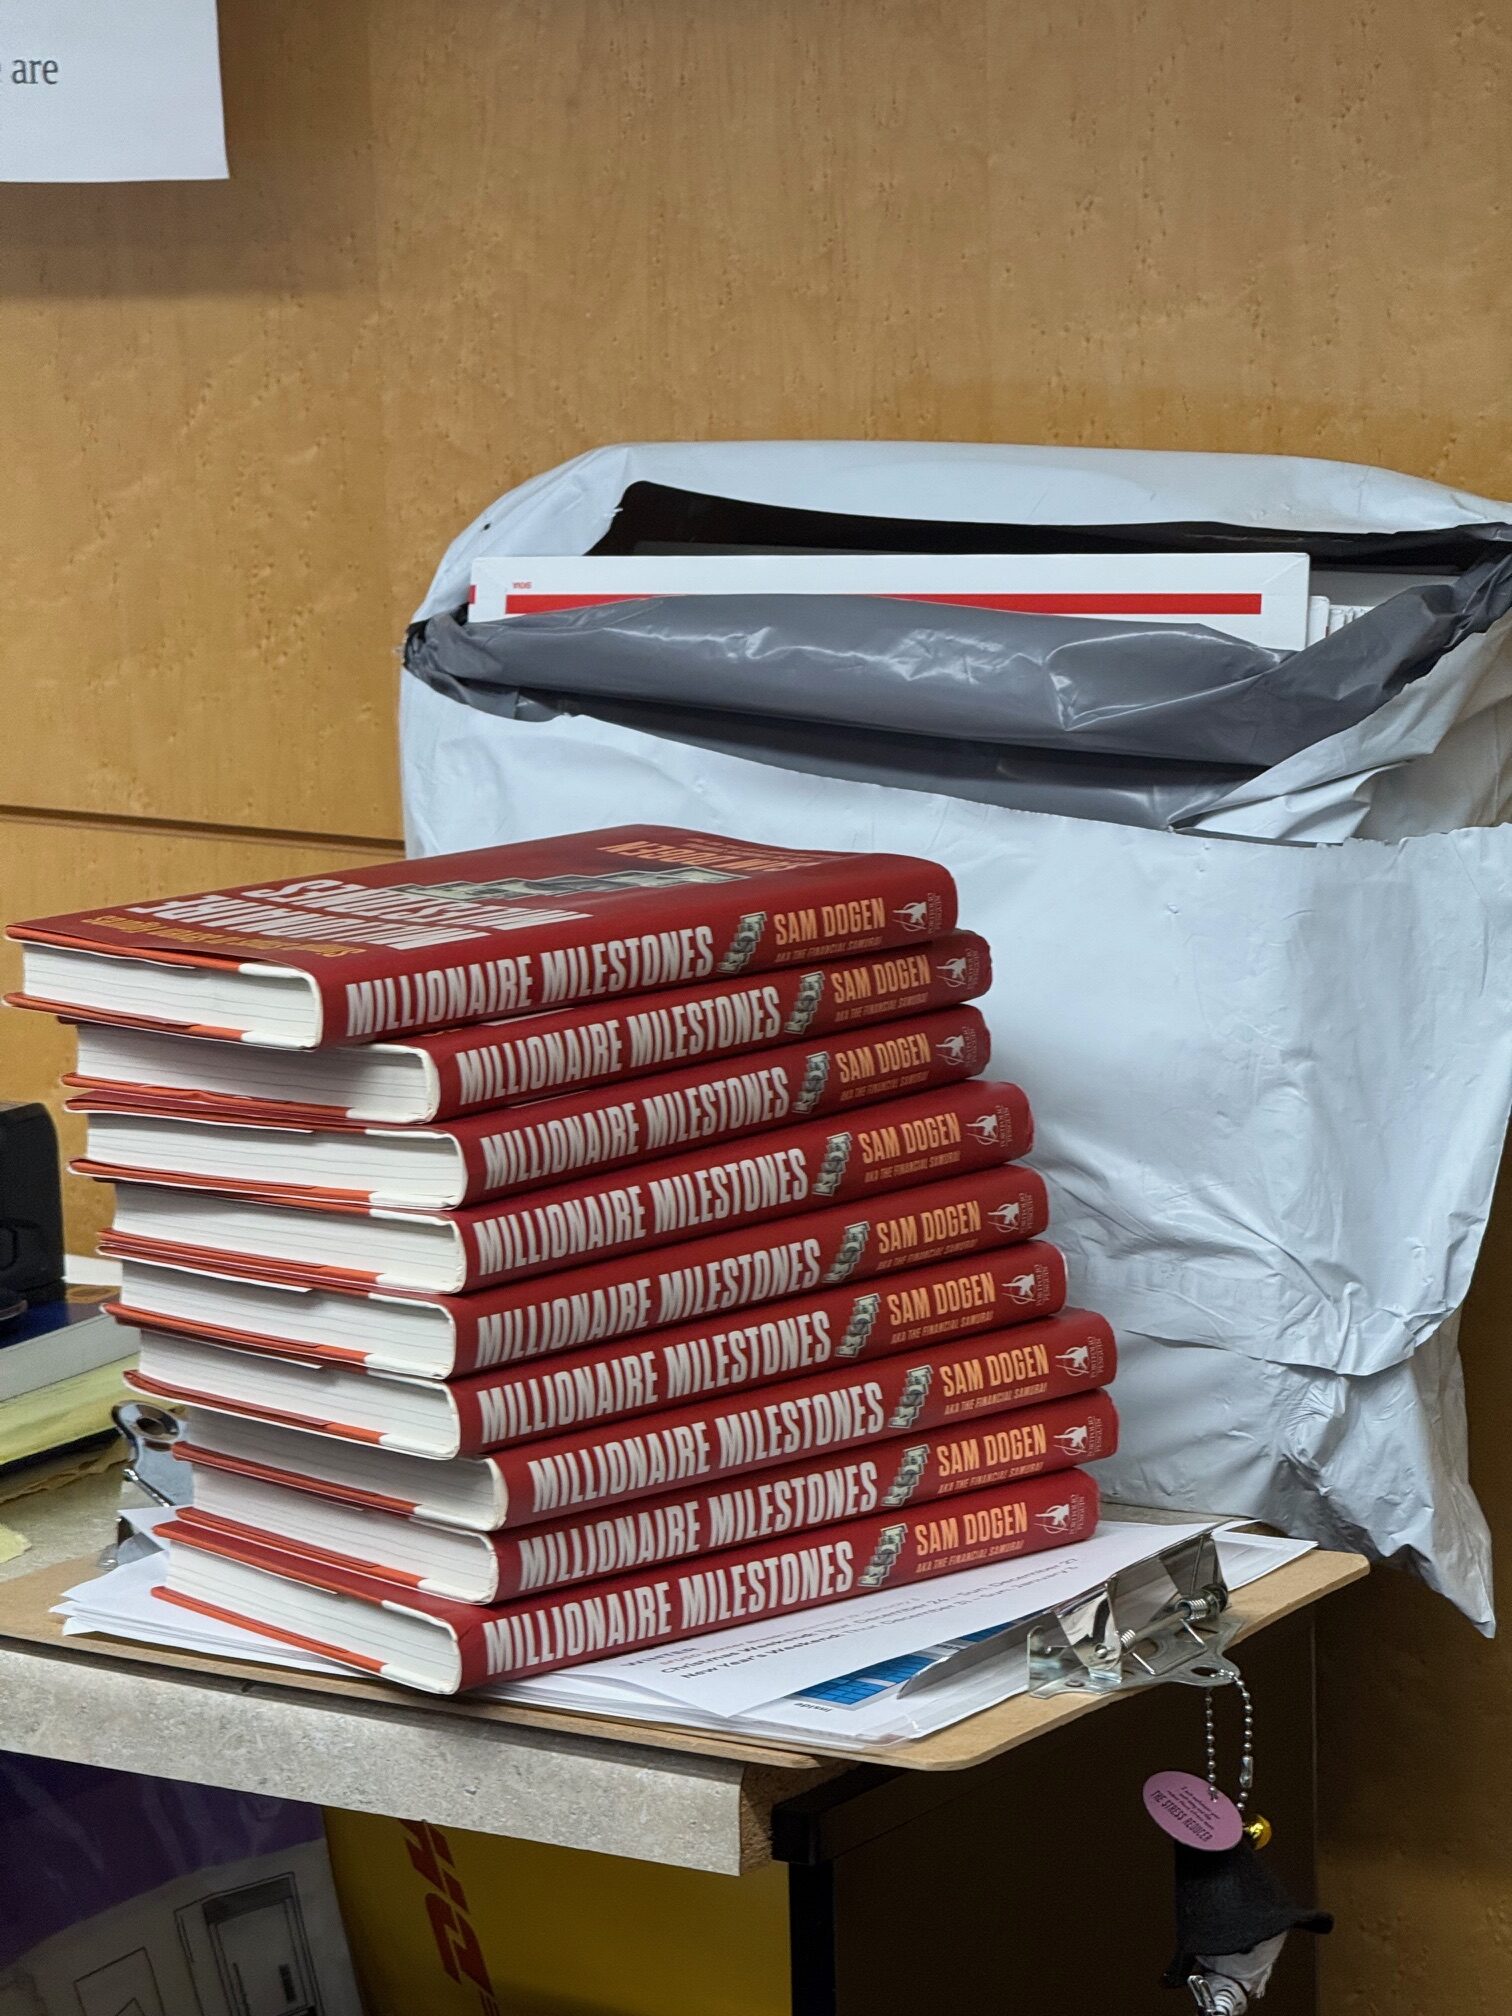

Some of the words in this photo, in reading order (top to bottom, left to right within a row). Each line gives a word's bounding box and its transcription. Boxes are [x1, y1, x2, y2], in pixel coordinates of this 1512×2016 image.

[12, 60, 58, 84] are
[125, 895, 492, 950] MILLIONAIRE
[240, 879, 594, 931] MILESTONES
[773, 908, 817, 945] SAM
[821, 897, 885, 937] DOGEN
[345, 955, 532, 1033] MILLIONAIRE
[540, 925, 713, 991] MILESTONES
[830, 967, 871, 1003] SAM
[872, 957, 930, 995] DOGEN
[455, 1019, 622, 1096] MILLIONAIRE
[626, 986, 780, 1057] MILESTONES
[835, 1046, 874, 1083] SAM
[873, 1033, 930, 1073] DOGEN
[480, 1102, 639, 1177] MILLIONAIRE
[642, 1066, 788, 1136] MILESTONES
[857, 1126, 900, 1164] SAM
[900, 1112, 961, 1154] DOGEN
[472, 1185, 645, 1275] MILLIONAIRE
[648, 1148, 807, 1232] MILESTONES
[876, 1215, 918, 1254] SAM
[920, 1200, 981, 1243] DOGEN
[475, 1278, 651, 1368] MILLIONAIRE
[658, 1239, 821, 1323] MILESTONES
[886, 1287, 931, 1326] SAM
[932, 1271, 996, 1315] DOGEN
[476, 1350, 658, 1443] MILLIONAIRE
[663, 1310, 831, 1398] MILESTONES
[939, 1358, 984, 1397] SAM
[984, 1343, 1050, 1387] DOGEN
[975, 1392, 1013, 1409] FINANCIAL
[1014, 1382, 1047, 1399] SAMURAI
[527, 1421, 710, 1512] MILLIONAIRE
[714, 1381, 881, 1469] MILESTONES
[936, 1438, 980, 1477] SAM
[982, 1423, 1047, 1467] DOGEN
[968, 1472, 1008, 1488] FINANCIAL
[1009, 1461, 1044, 1478] SAMURAI
[519, 1501, 700, 1590] MILLIONAIRE
[708, 1461, 878, 1547] MILESTONES
[914, 1517, 959, 1556] SAM
[962, 1501, 1028, 1546] DOGEN
[948, 1551, 988, 1567] FINANCIAL
[988, 1540, 1025, 1557] SAMURAI
[482, 1581, 672, 1675] MILLIONAIRE
[678, 1540, 854, 1629] MILESTONES
[620, 1648, 699, 1667] WINTER
[661, 1650, 741, 1674] Christmas
[681, 1667, 718, 1680] New
[719, 1653, 768, 1669] Year's
[1150, 1790, 1167, 1803] THE
[1161, 1800, 1188, 1820] STRESS
[1182, 1817, 1213, 1842] REDUCER
